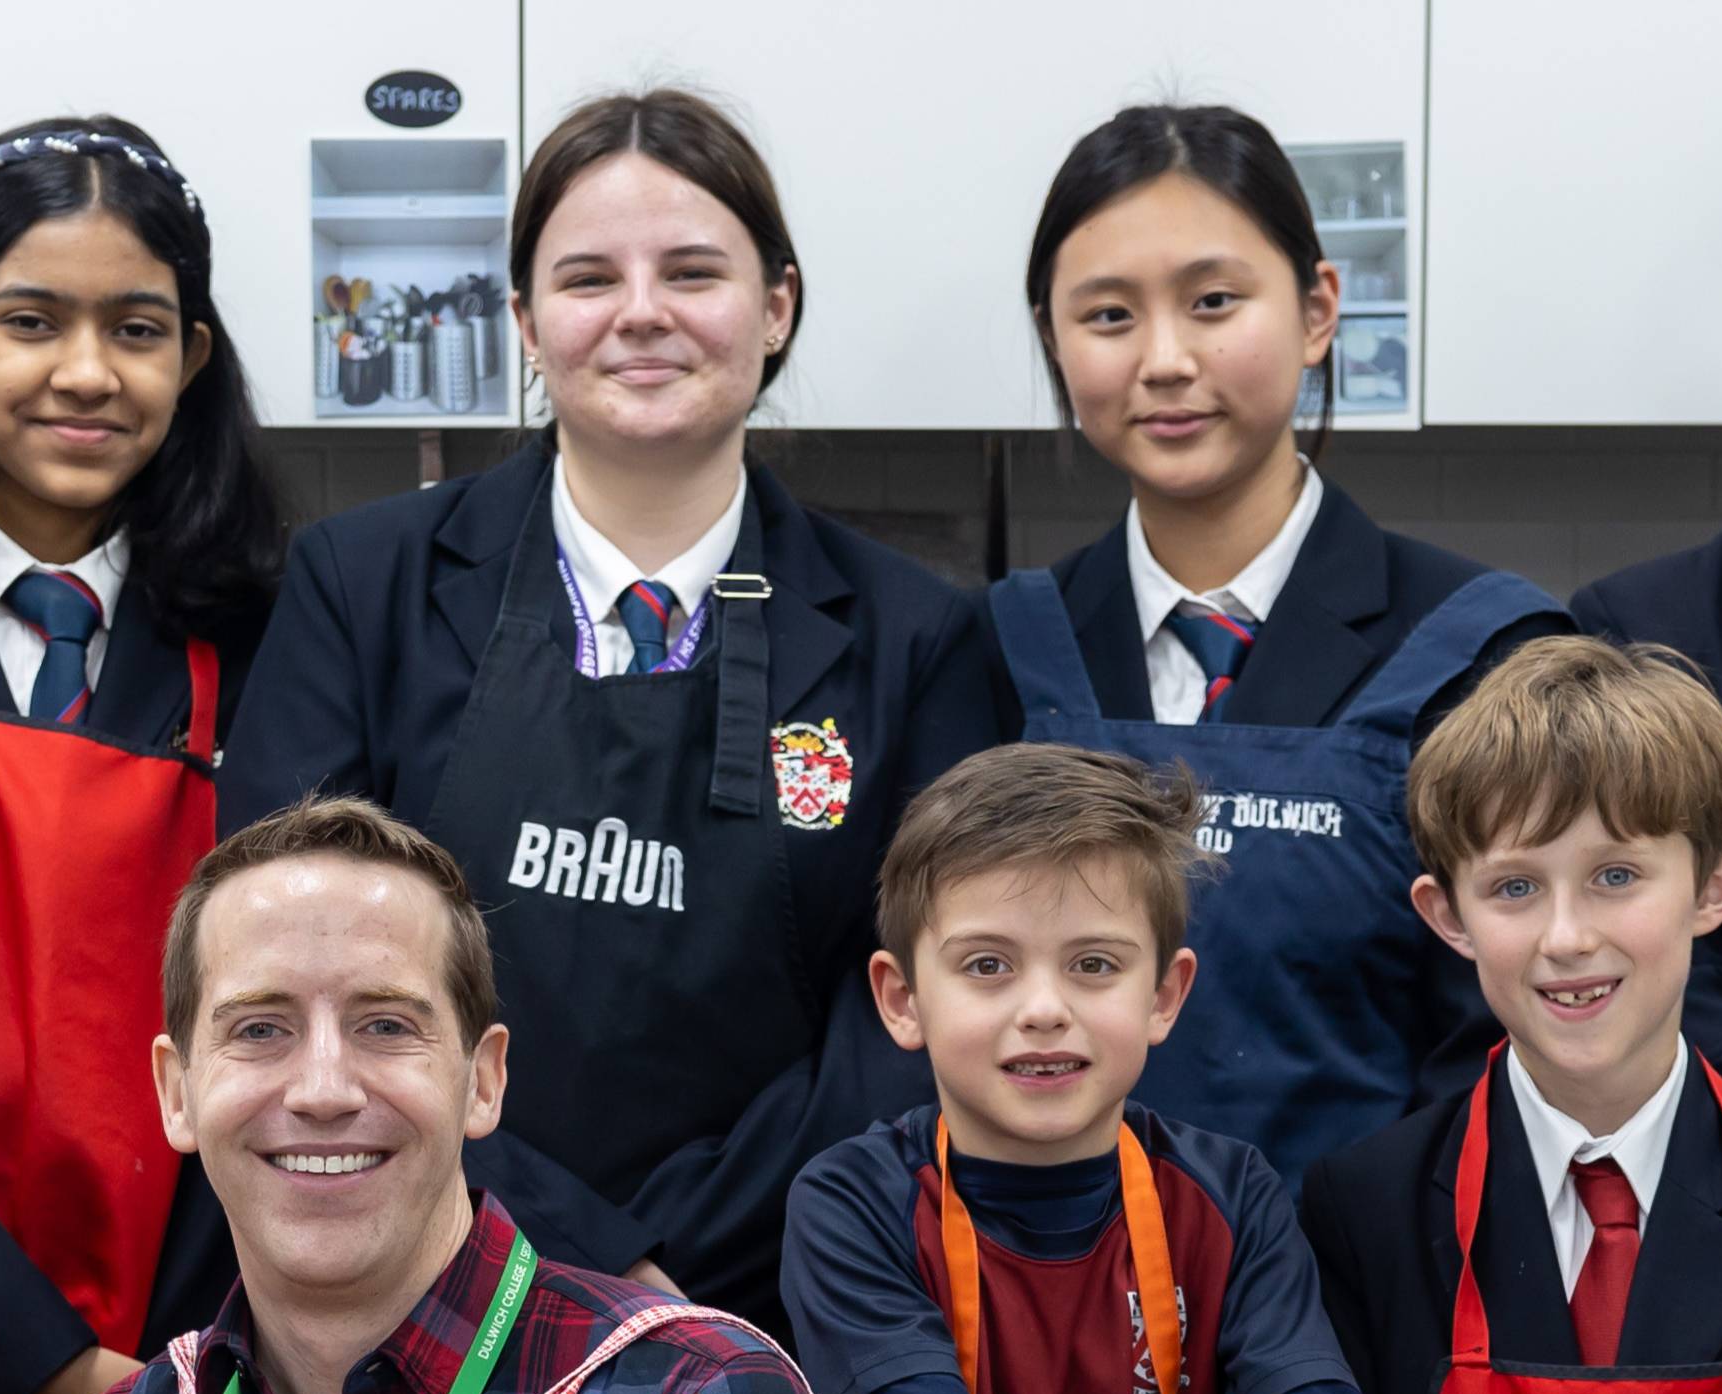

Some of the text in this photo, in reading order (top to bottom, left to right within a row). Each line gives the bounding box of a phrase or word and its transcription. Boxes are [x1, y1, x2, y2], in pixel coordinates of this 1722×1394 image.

[372, 84, 458, 112] SPARES
[508, 817, 685, 911] BRAUN
[479, 1309, 508, 1359] DULWICH
[503, 1265, 527, 1307] COLLEGE
